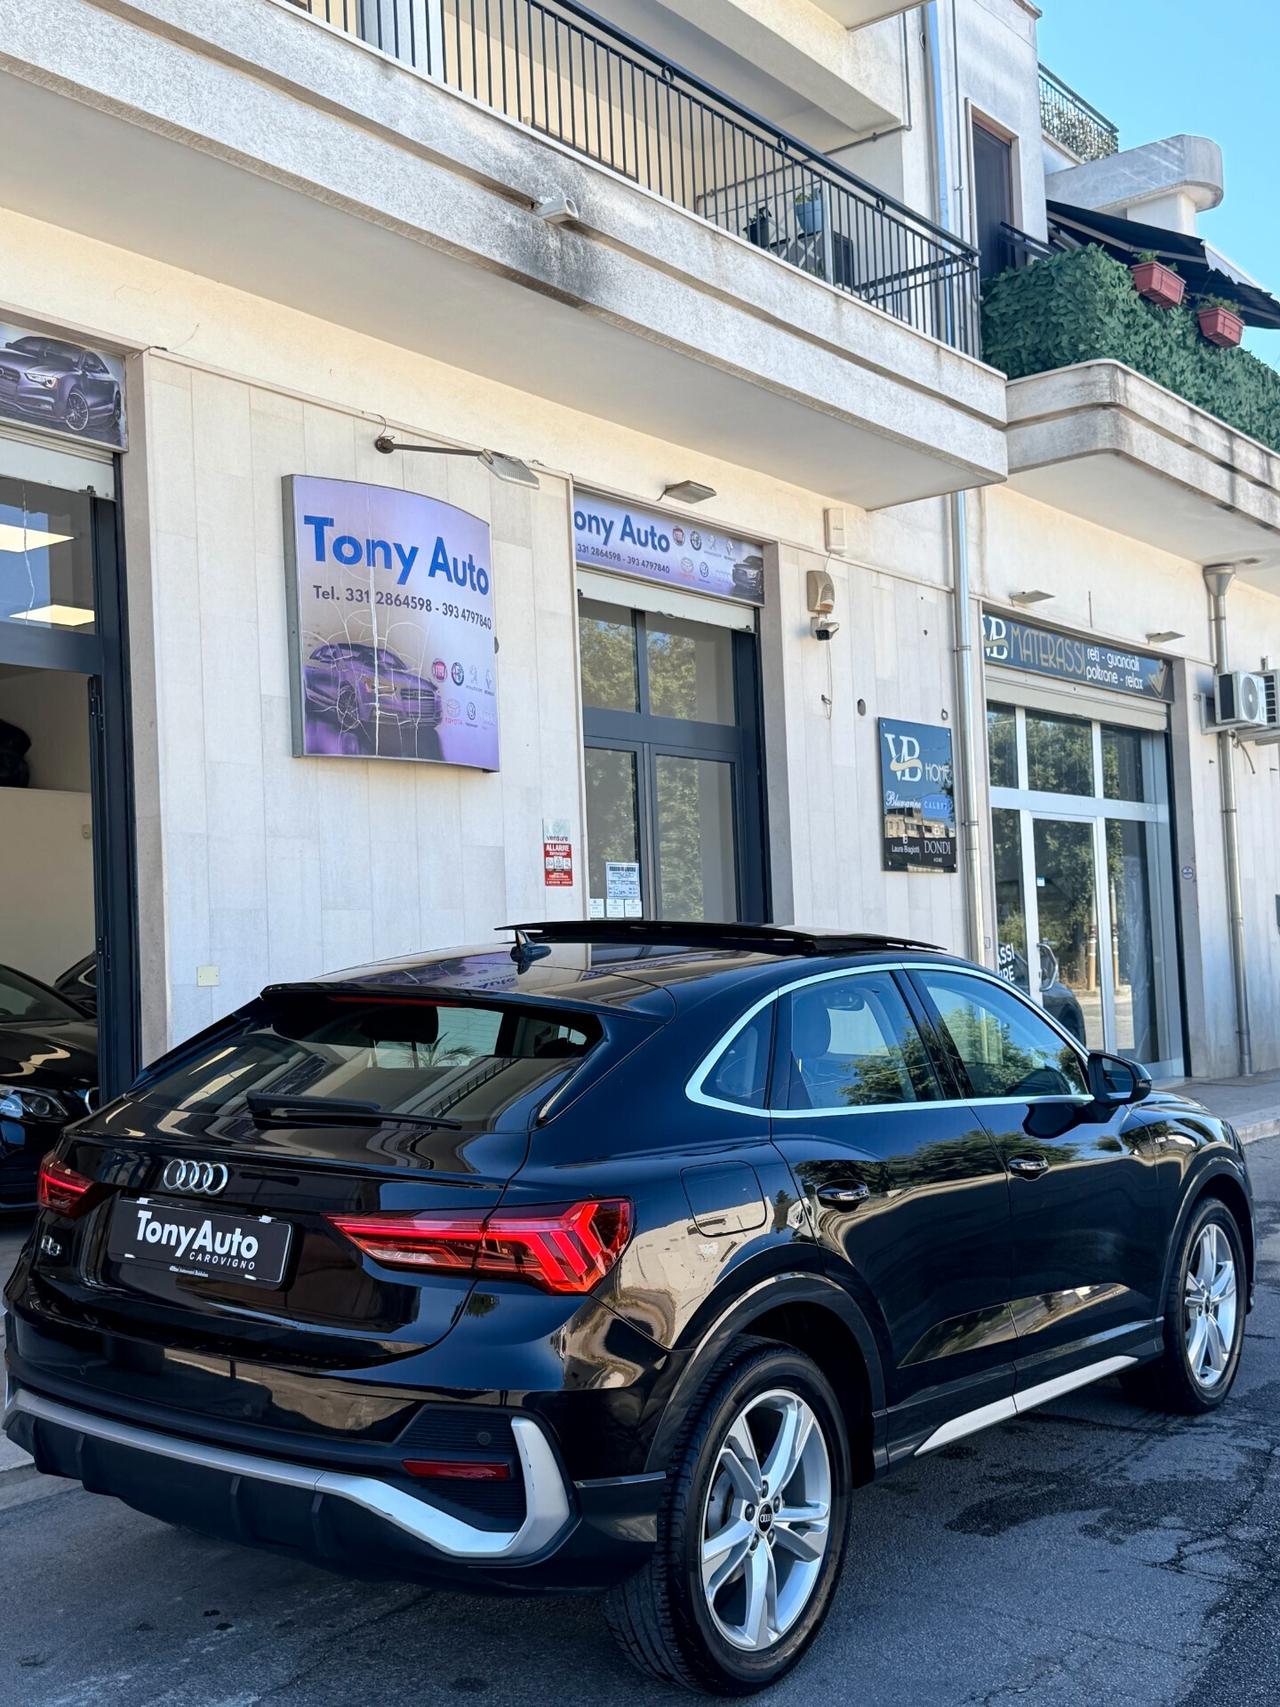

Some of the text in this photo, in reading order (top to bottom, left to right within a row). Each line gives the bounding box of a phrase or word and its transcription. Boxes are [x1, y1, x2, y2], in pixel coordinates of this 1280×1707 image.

[620, 515, 670, 553] Auto
[304, 515, 490, 595] Tony Auto
[627, 556, 640, 567] 393
[641, 560, 670, 574] 4797840
[313, 585, 340, 600] Tel.
[345, 587, 371, 602] 331
[375, 590, 433, 612] 2864598
[442, 604, 459, 619] 393
[461, 608, 492, 630] 4797840
[1010, 625, 1086, 676] MATERASSI
[1087, 646, 1100, 661] reti
[1107, 653, 1140, 671] guanciali
[1086, 664, 1118, 685] poltrone
[1125, 673, 1143, 690] relax
[136, 1210, 259, 1259] TonyAuto
[189, 1250, 255, 1271] CAROVIGNO
